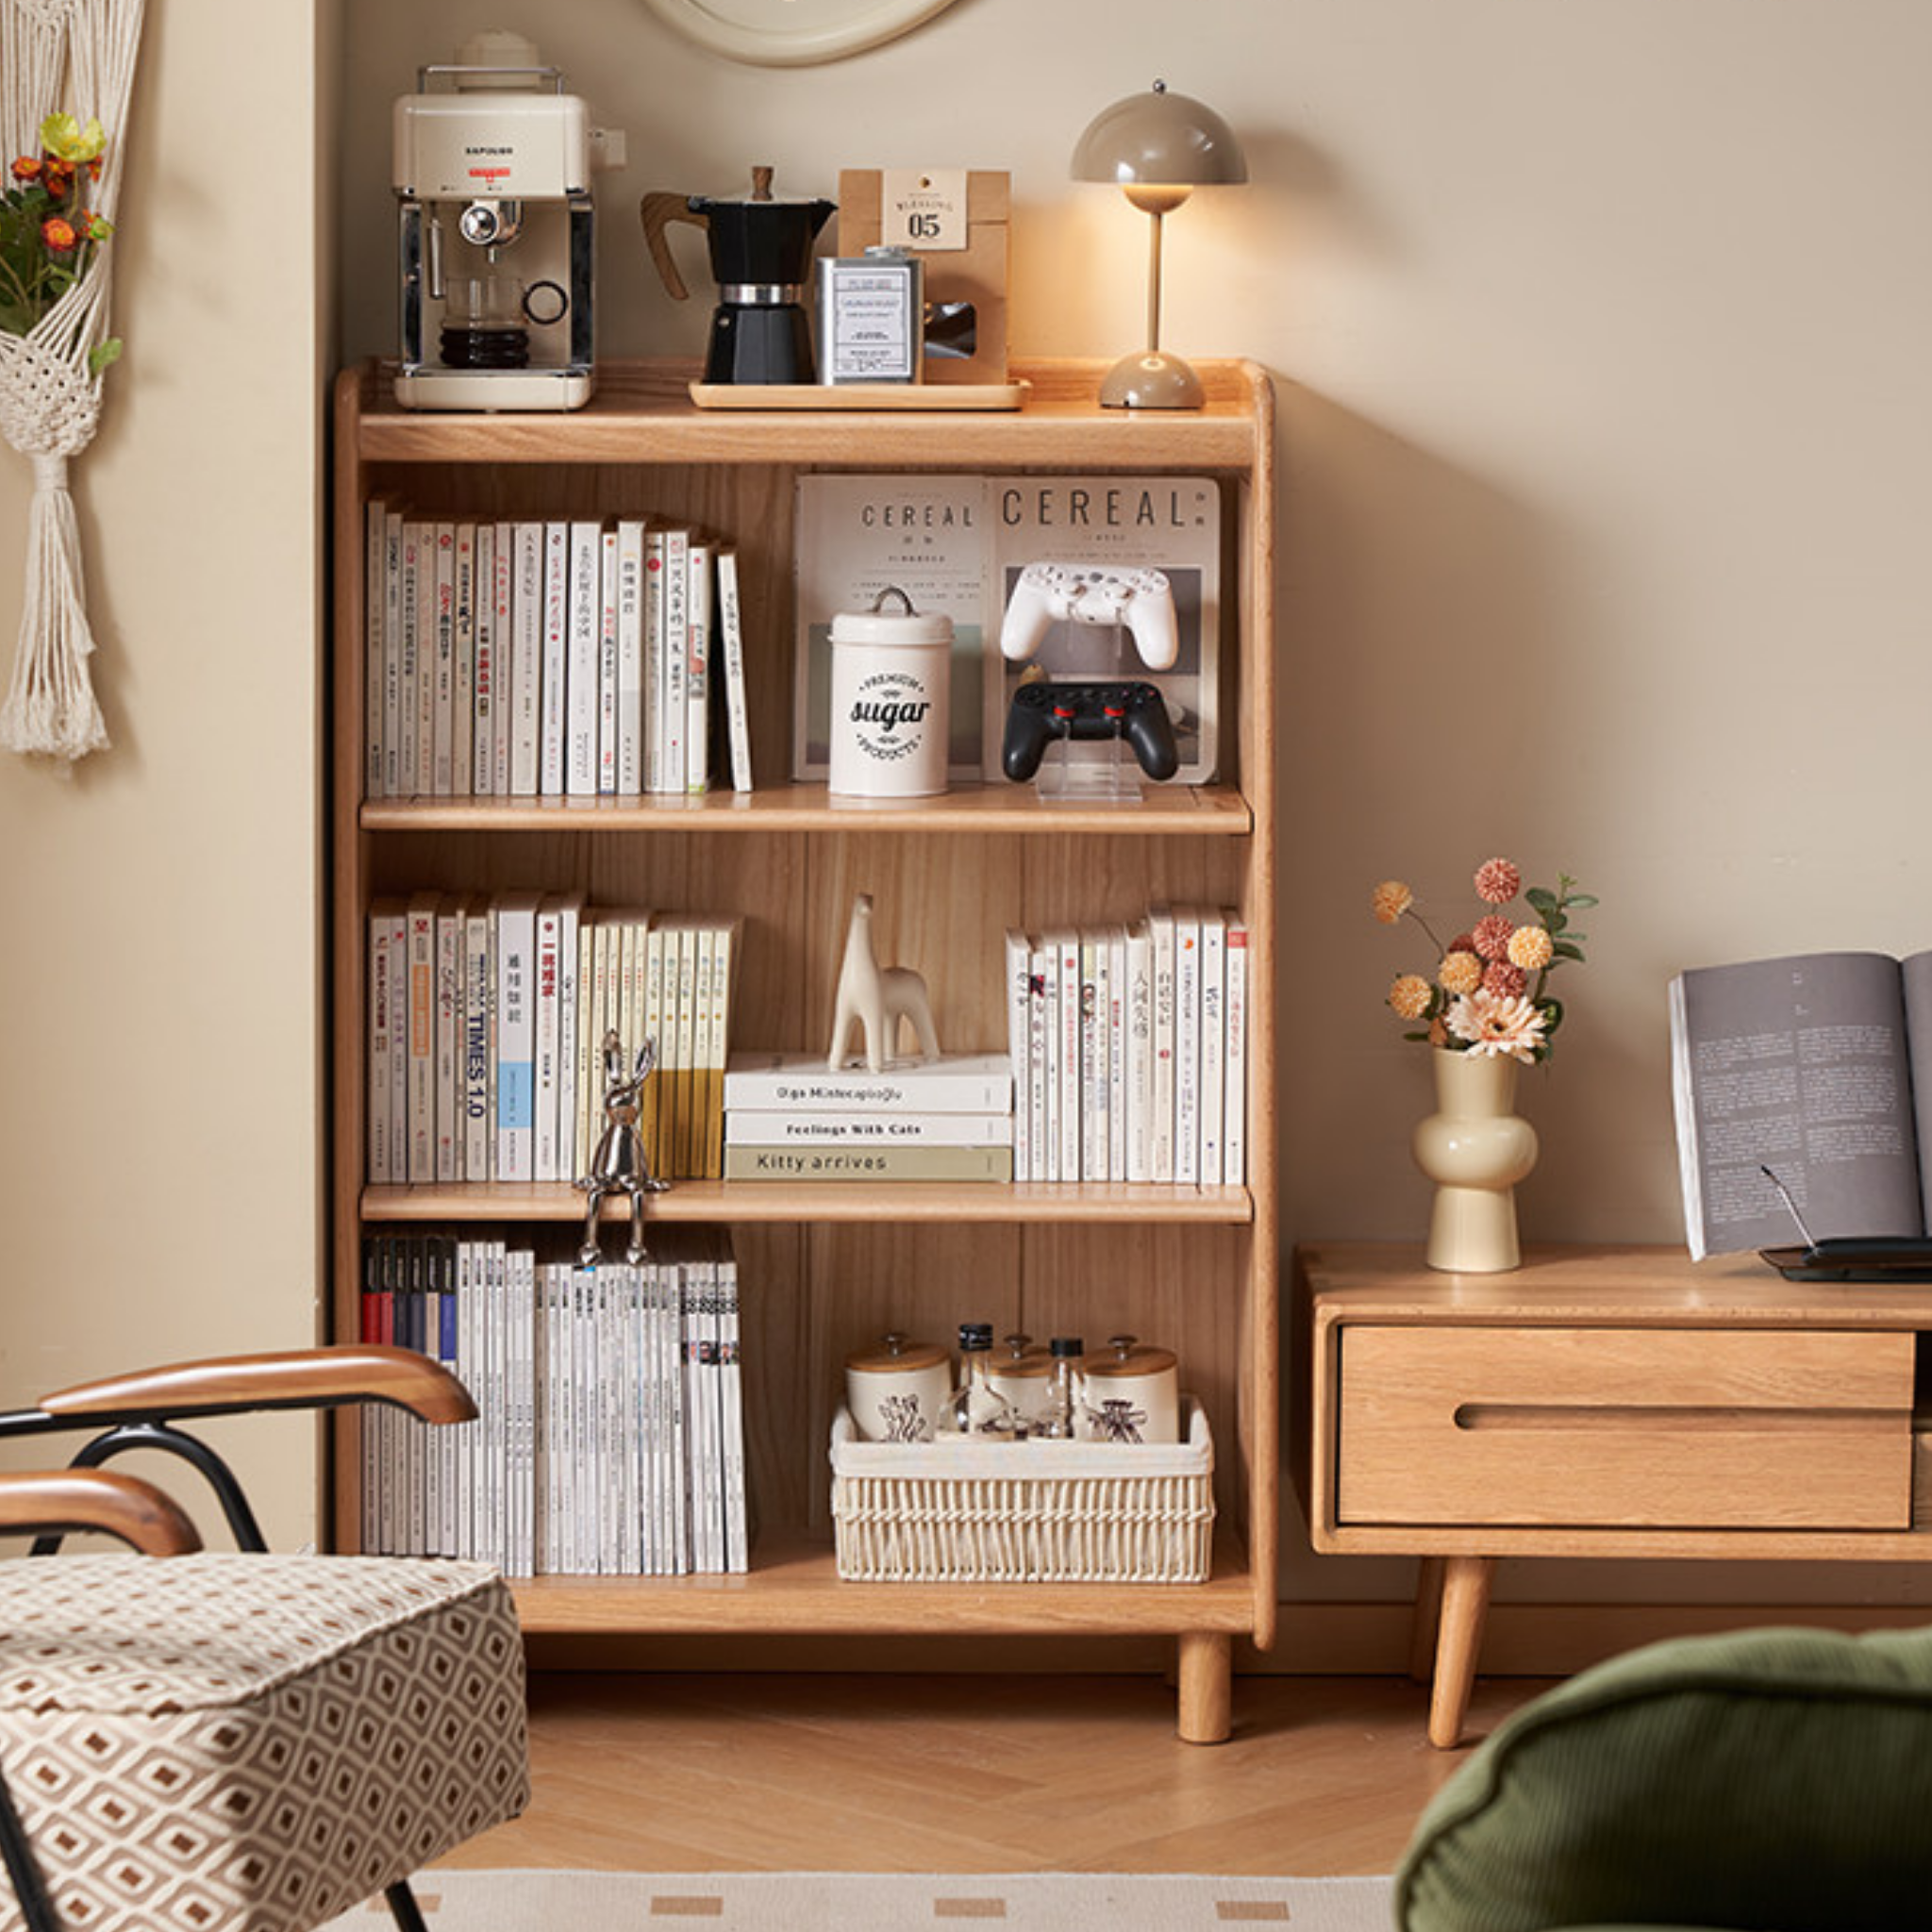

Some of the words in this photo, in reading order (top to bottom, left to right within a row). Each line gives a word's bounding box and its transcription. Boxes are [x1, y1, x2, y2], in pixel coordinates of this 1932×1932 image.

[908, 213, 941, 239] 05
[861, 504, 973, 528] CEREAL
[1003, 488, 1186, 527] CEREAL
[850, 700, 931, 733] sugar
[469, 1012, 485, 1080] TIMES
[469, 1086, 485, 1118] 1.0
[786, 1123, 847, 1137] Feelings
[851, 1123, 884, 1135] With
[889, 1123, 922, 1136] Cats
[757, 1154, 805, 1173] Kitty
[812, 1154, 887, 1170] arrives
